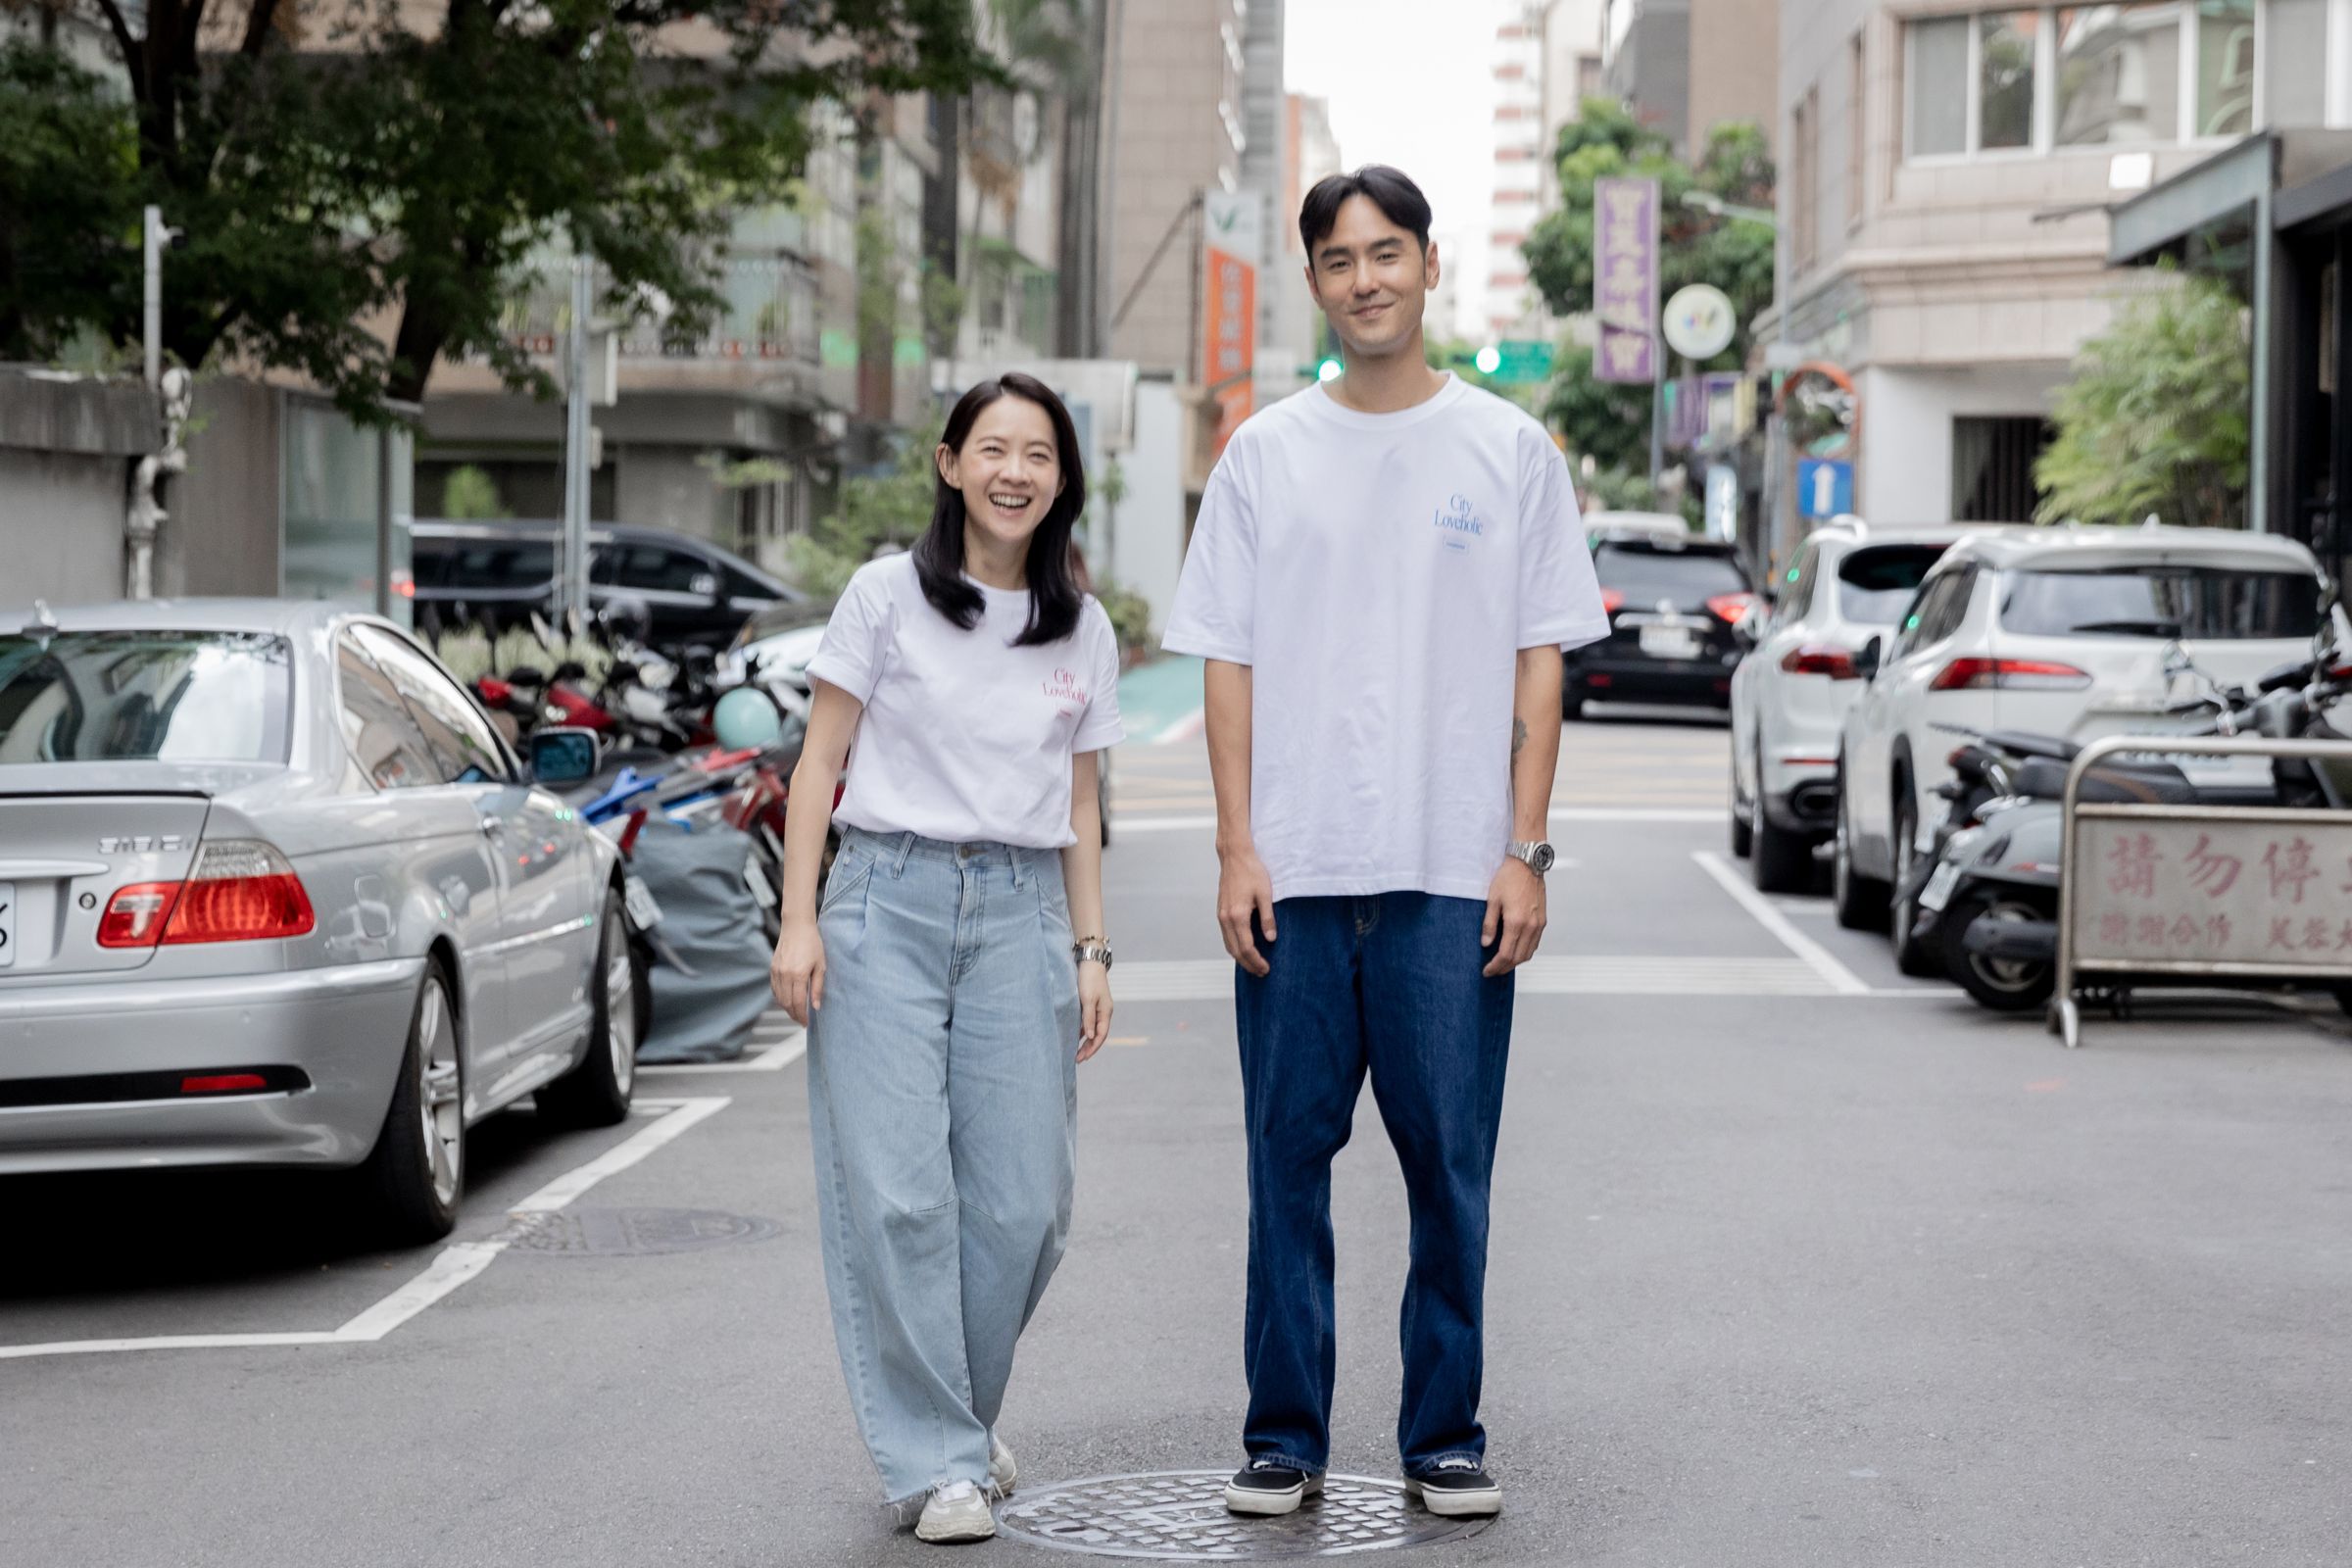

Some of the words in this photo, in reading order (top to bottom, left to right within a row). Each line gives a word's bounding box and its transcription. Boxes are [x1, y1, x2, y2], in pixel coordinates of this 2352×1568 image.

[1450, 493, 1473, 516] City
[1054, 667, 1076, 689] City
[2106, 832, 2352, 904] 請勿停
